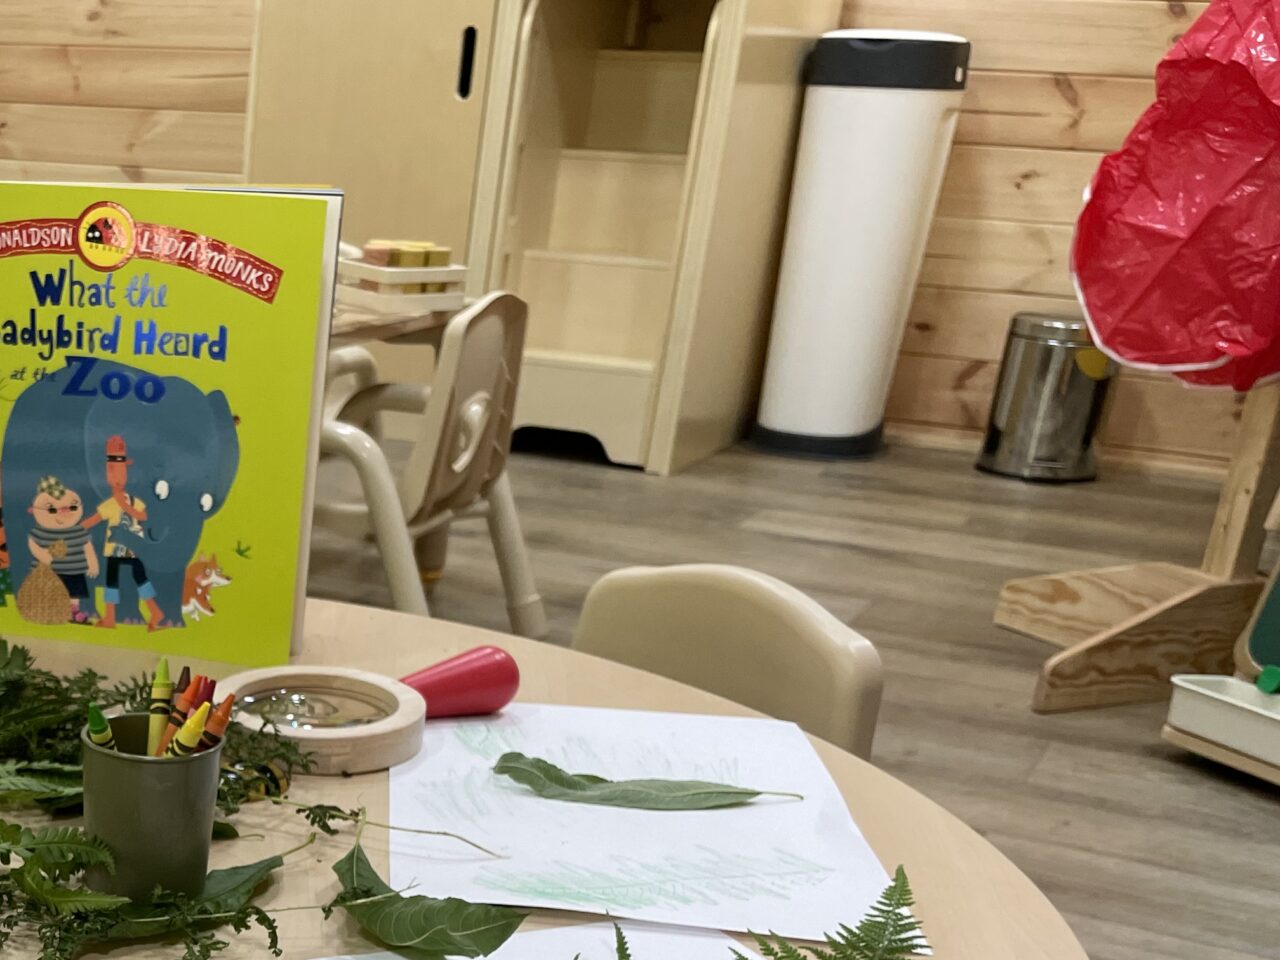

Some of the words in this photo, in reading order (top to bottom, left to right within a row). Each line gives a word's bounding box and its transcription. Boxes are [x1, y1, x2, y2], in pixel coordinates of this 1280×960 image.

[29, 258, 117, 309] What
[123, 272, 168, 308] the
[138, 230, 198, 262] LYDIA
[206, 249, 274, 293] MONKS
[132, 318, 229, 362] Heard
[9, 367, 26, 382] at
[32, 366, 57, 383] the
[60, 355, 167, 405] Zoo
